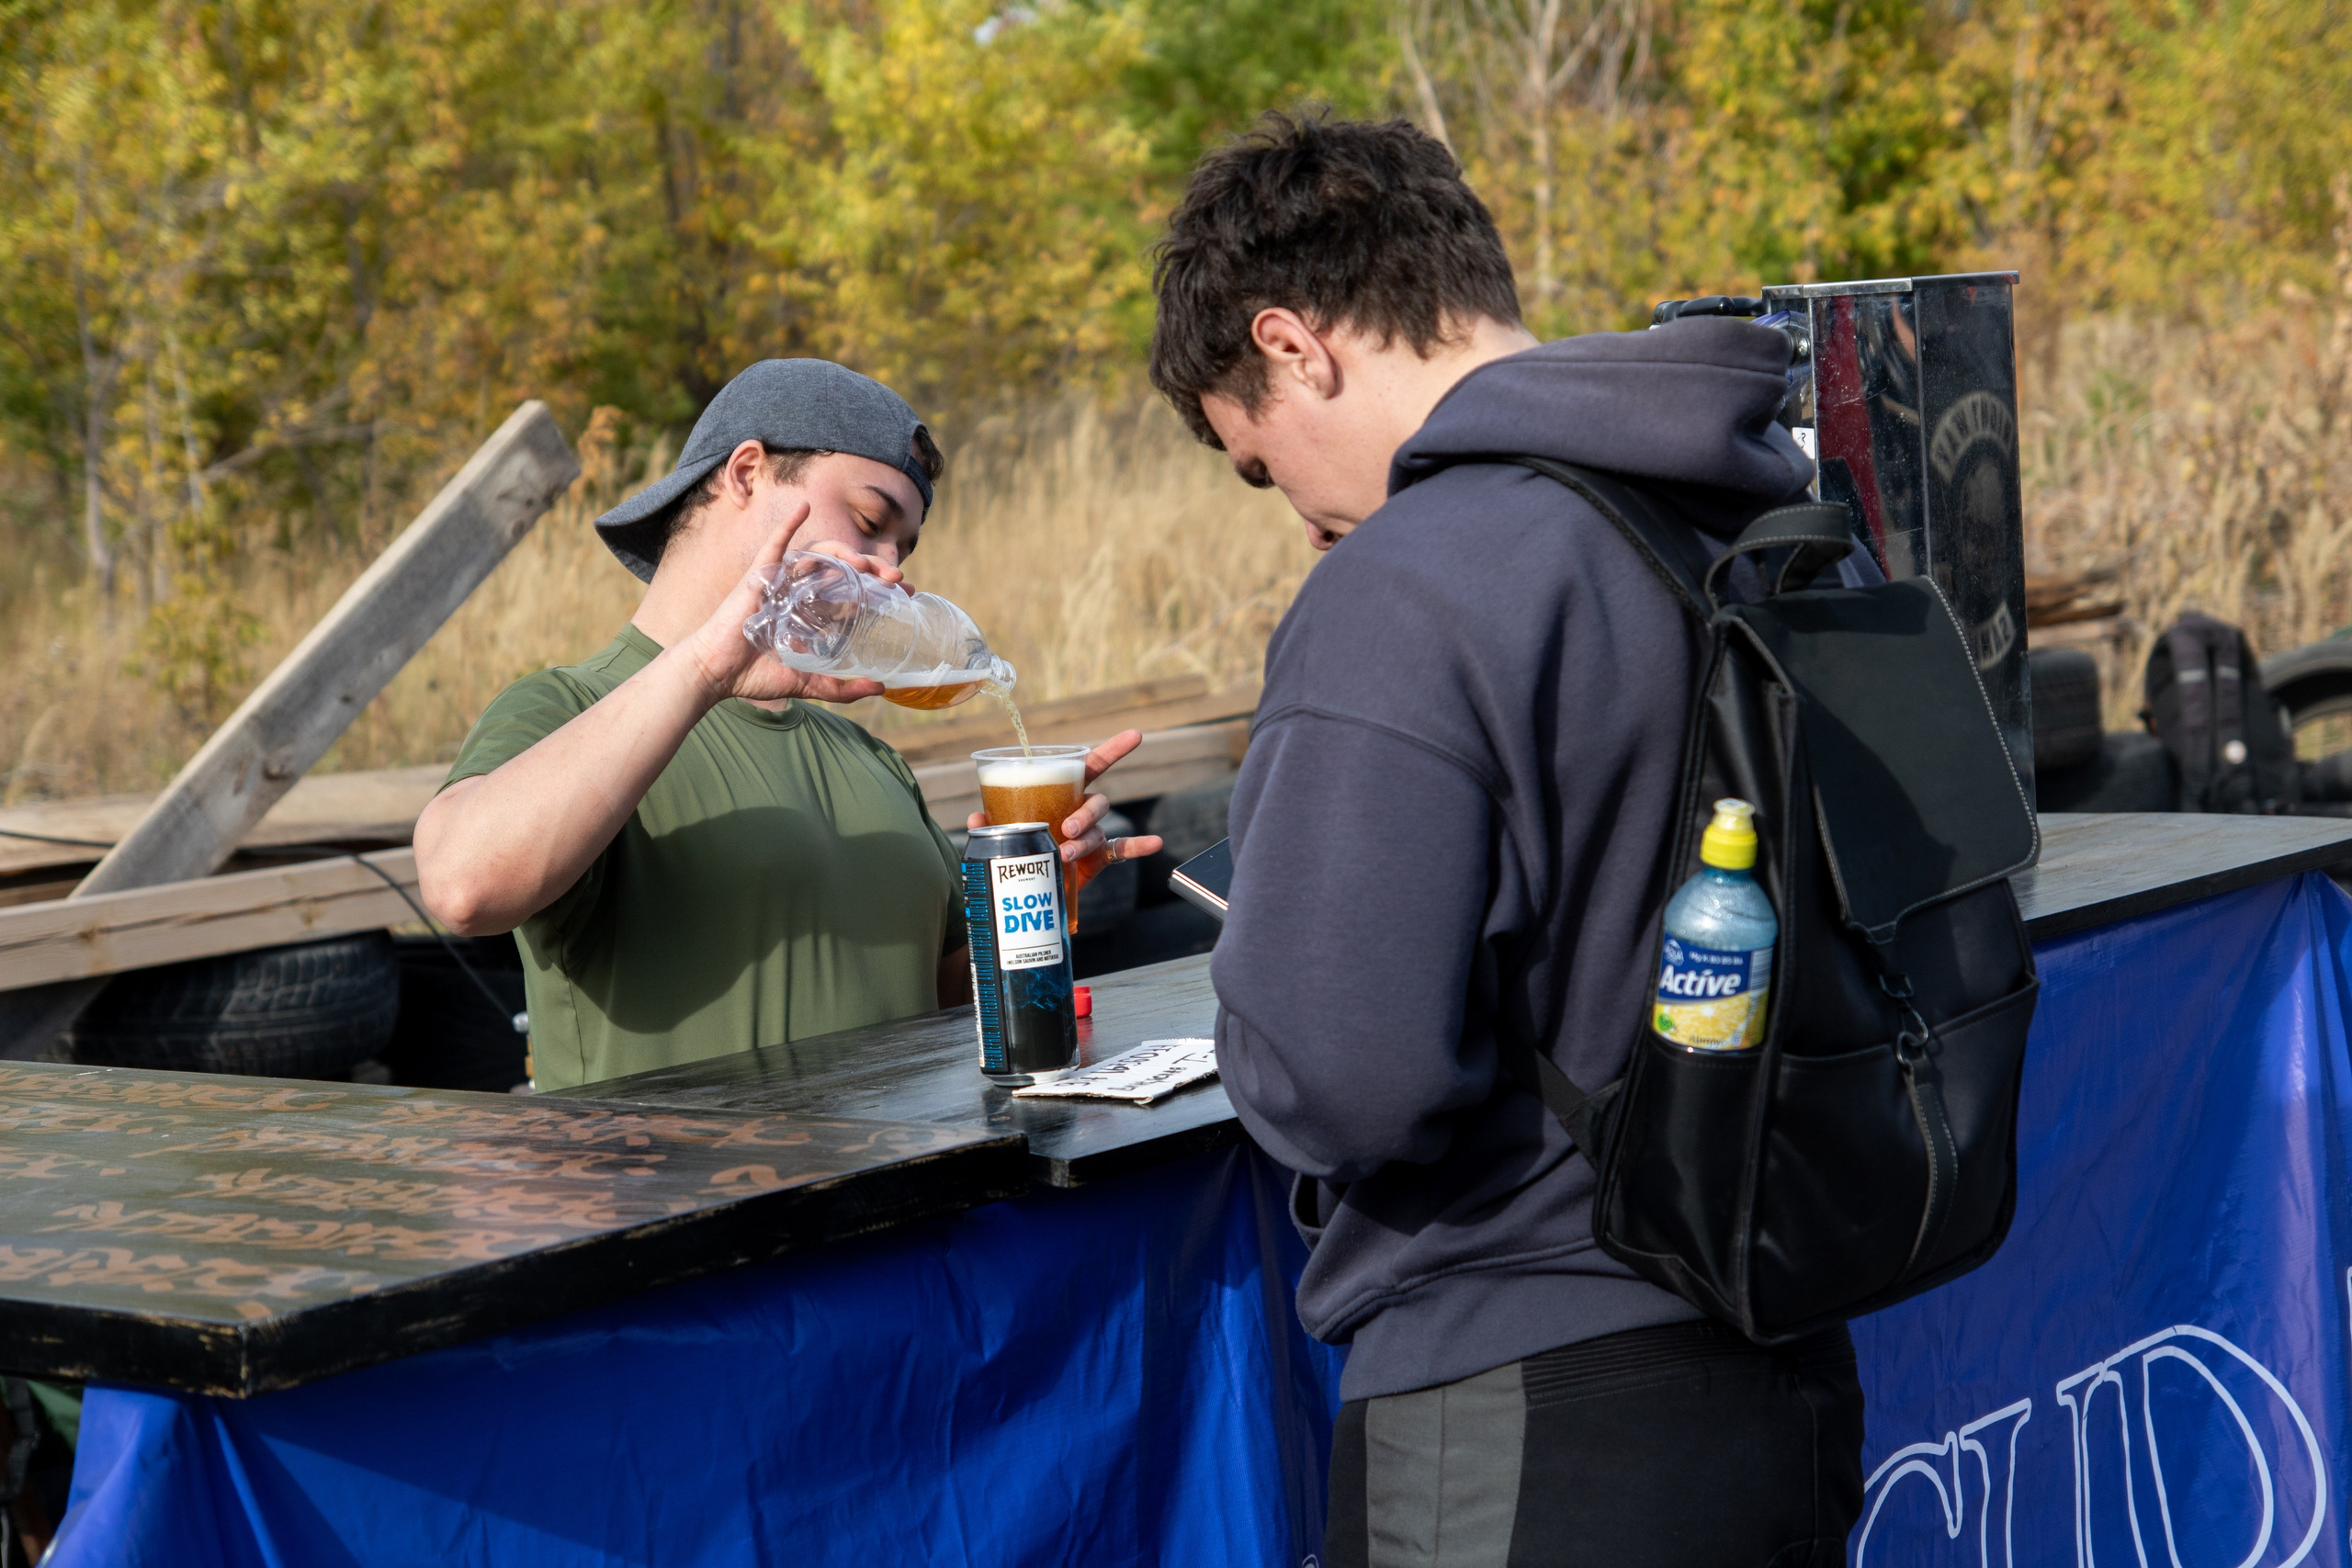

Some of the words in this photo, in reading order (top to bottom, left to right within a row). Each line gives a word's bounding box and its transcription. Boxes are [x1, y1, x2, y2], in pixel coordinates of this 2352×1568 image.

[997, 860, 1050, 884] REWORT
[1002, 891, 1052, 912] SLOW
[1004, 909, 1055, 933] DIVE
